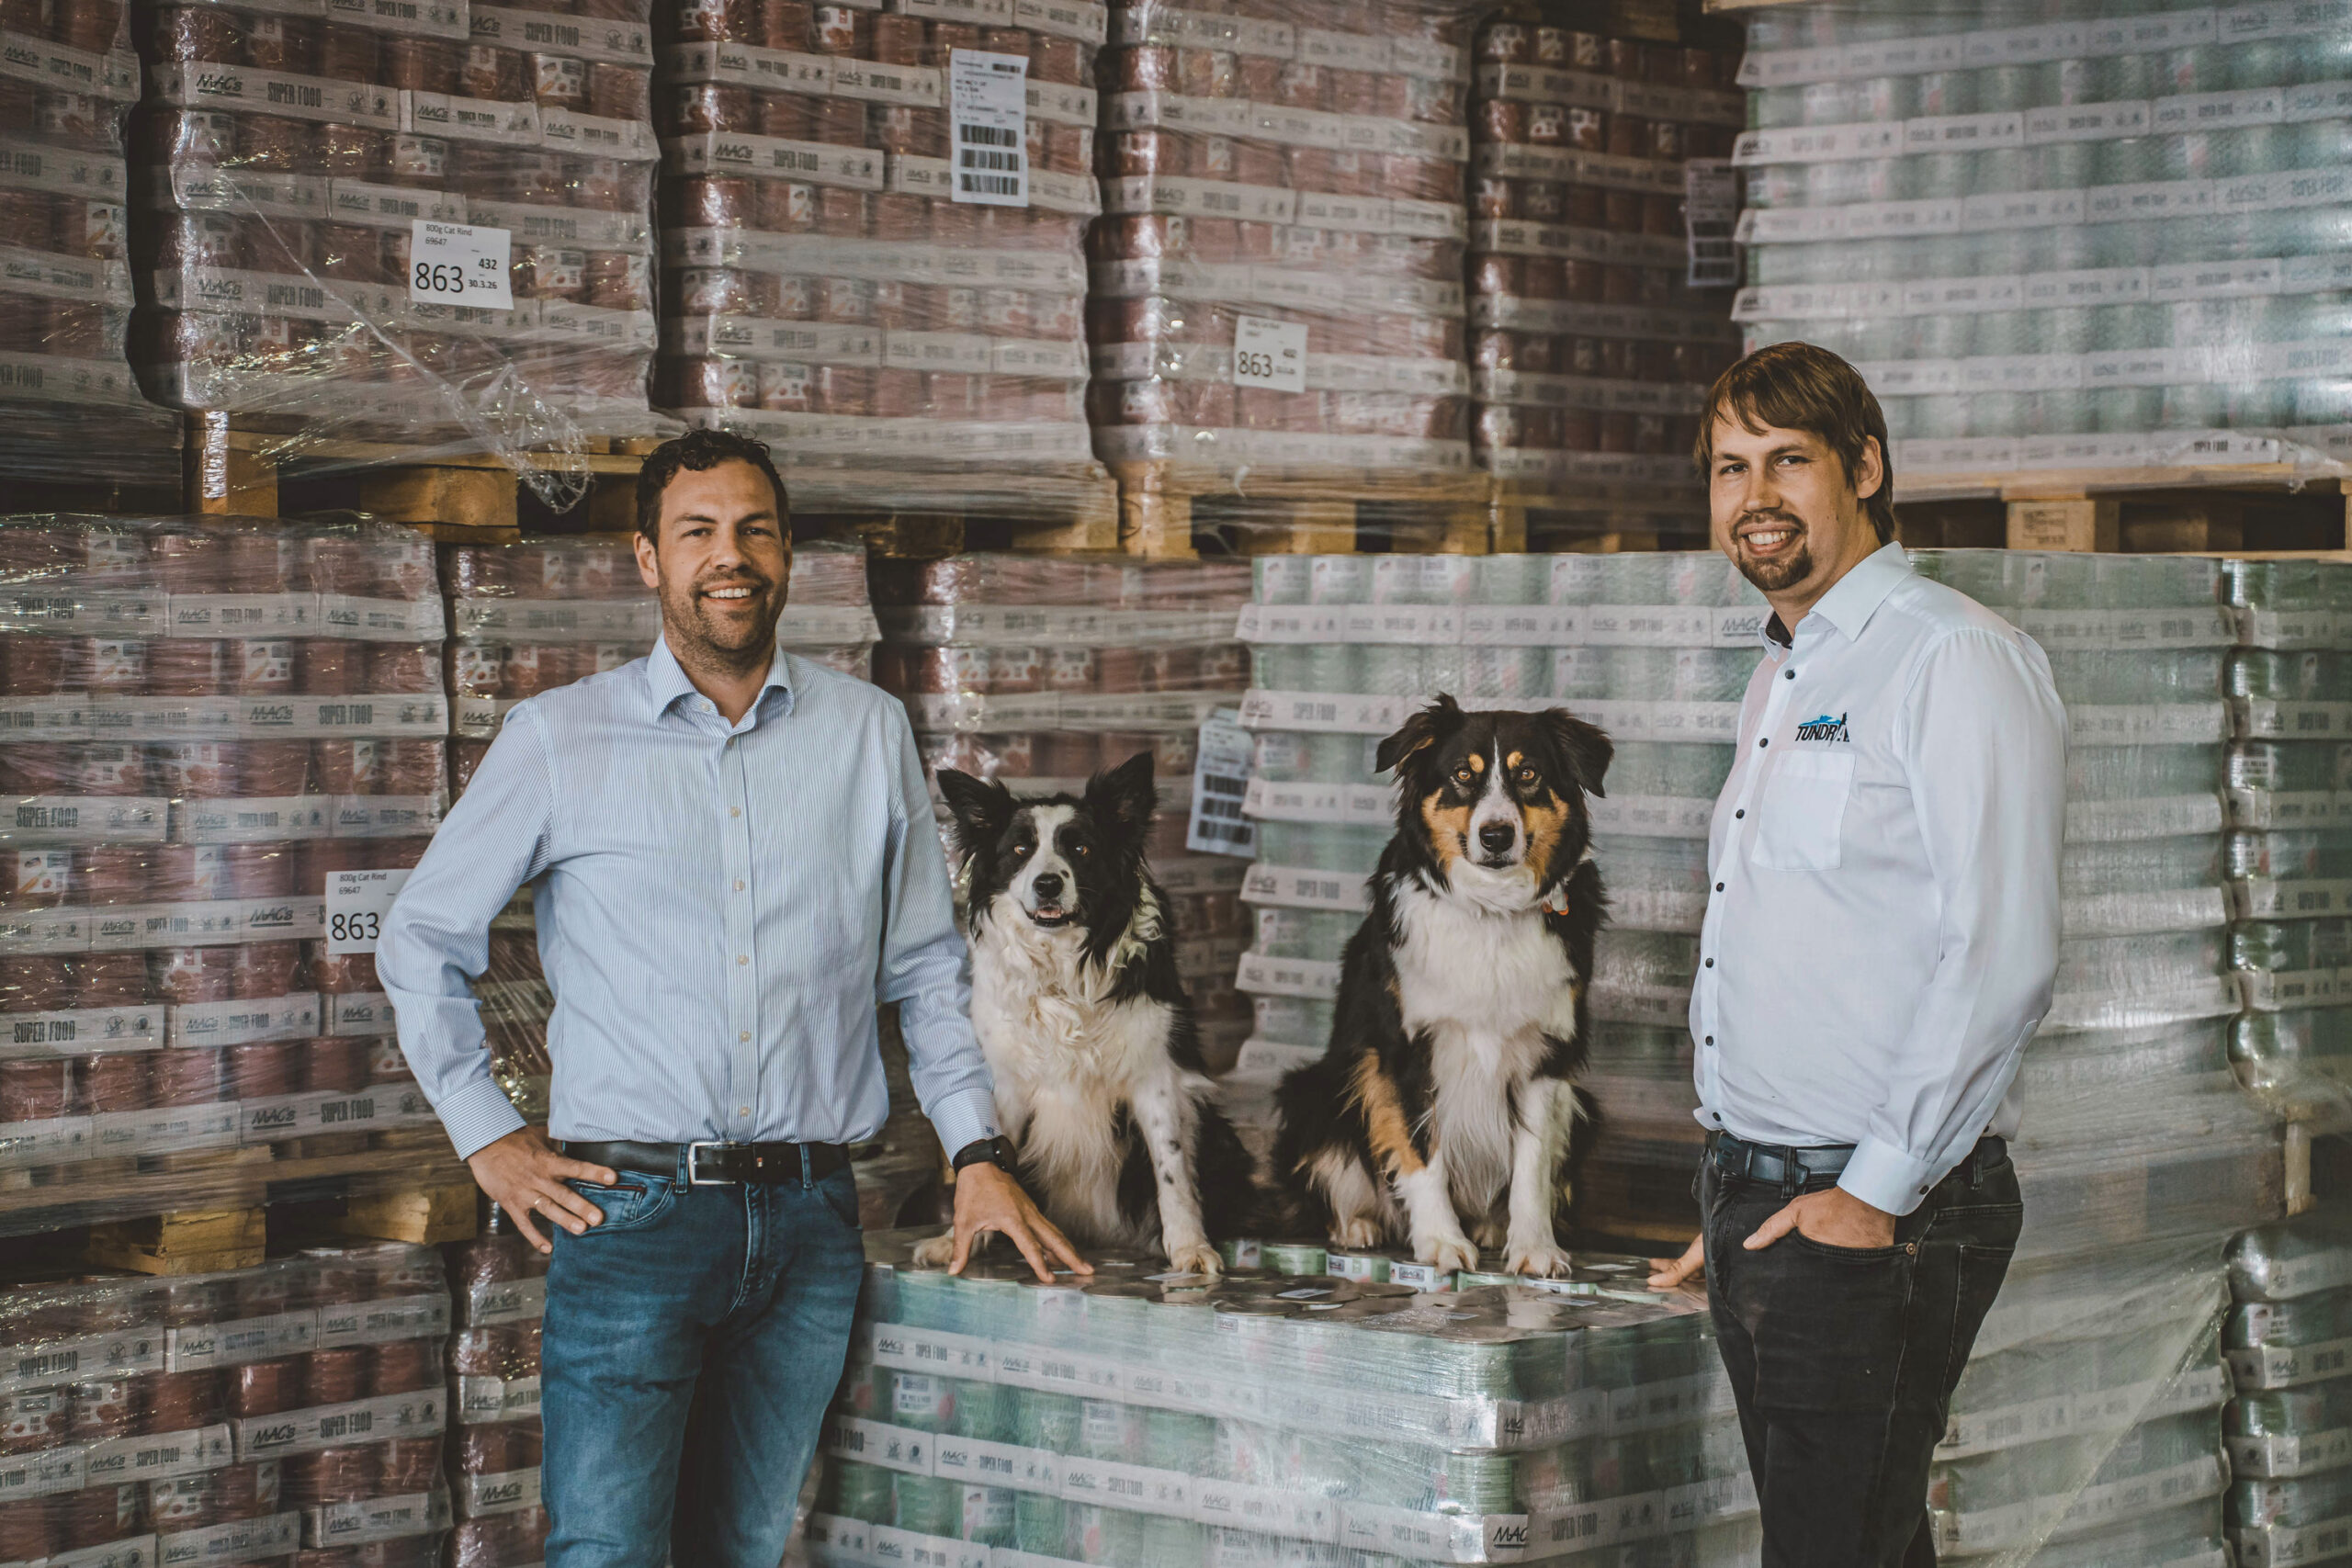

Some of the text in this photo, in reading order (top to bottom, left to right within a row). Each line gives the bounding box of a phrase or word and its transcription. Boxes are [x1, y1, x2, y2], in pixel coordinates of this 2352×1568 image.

[556, 25, 579, 46] FOOD
[267, 82, 295, 104] SUPER
[297, 85, 322, 107] FOOD
[425, 224, 472, 236] 800g Cat Rind
[425, 237, 447, 246] 69647
[479, 258, 497, 270] 432
[415, 263, 464, 293] 863
[469, 278, 498, 289] 30.3.26
[267, 285, 295, 305] SUPER
[300, 287, 323, 309] FOOD
[1238, 351, 1272, 378] 863
[319, 705, 345, 724] SUPER
[350, 705, 373, 724] FOOD
[1795, 716, 1849, 743] TUNDRA
[17, 807, 46, 828] SUPER
[340, 874, 356, 882] 800g
[338, 886, 360, 895] 69647
[249, 906, 294, 921] MAC's
[332, 912, 379, 941] 863
[14, 1021, 75, 1043] SUPER FOOD
[252, 1099, 374, 1125] MAC's SUPER FOOD
[19, 1350, 78, 1378] SUPER FOOD
[253, 1411, 372, 1442] MAC's SUPER FOOD
[92, 1447, 180, 1469] MAC's SUPER FOOD
